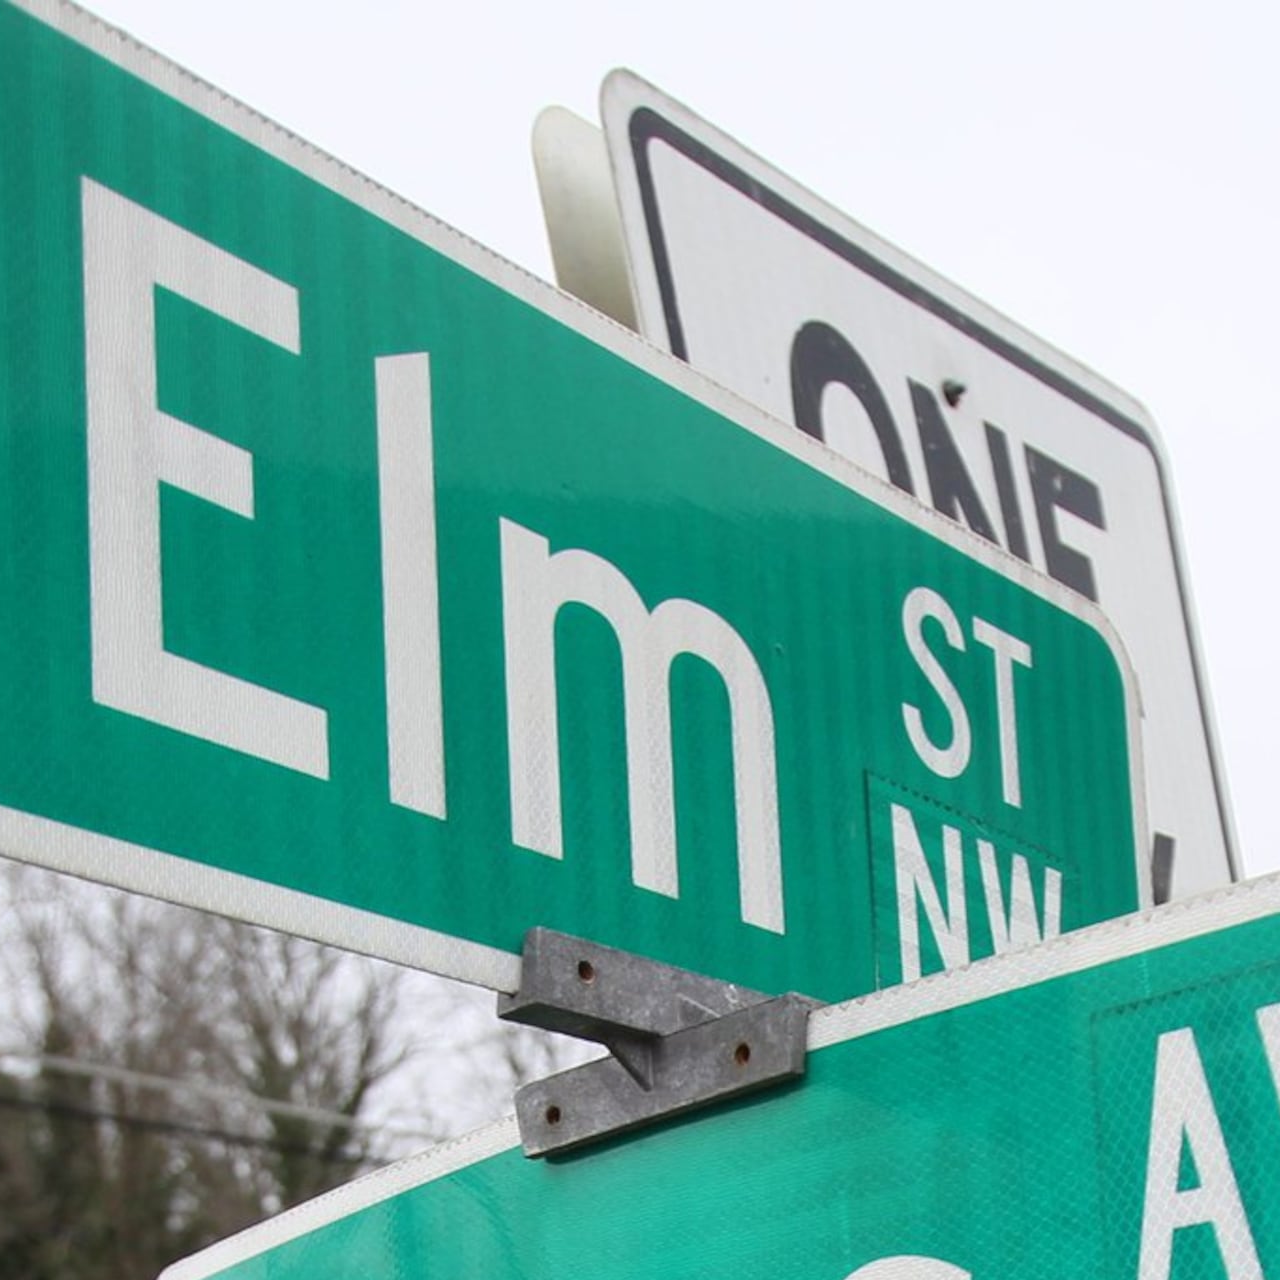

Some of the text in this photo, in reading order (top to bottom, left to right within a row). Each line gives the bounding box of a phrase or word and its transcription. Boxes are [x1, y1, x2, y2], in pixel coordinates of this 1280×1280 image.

[80, 175, 1032, 936] Elm ST
[891, 803, 1062, 982] NW
